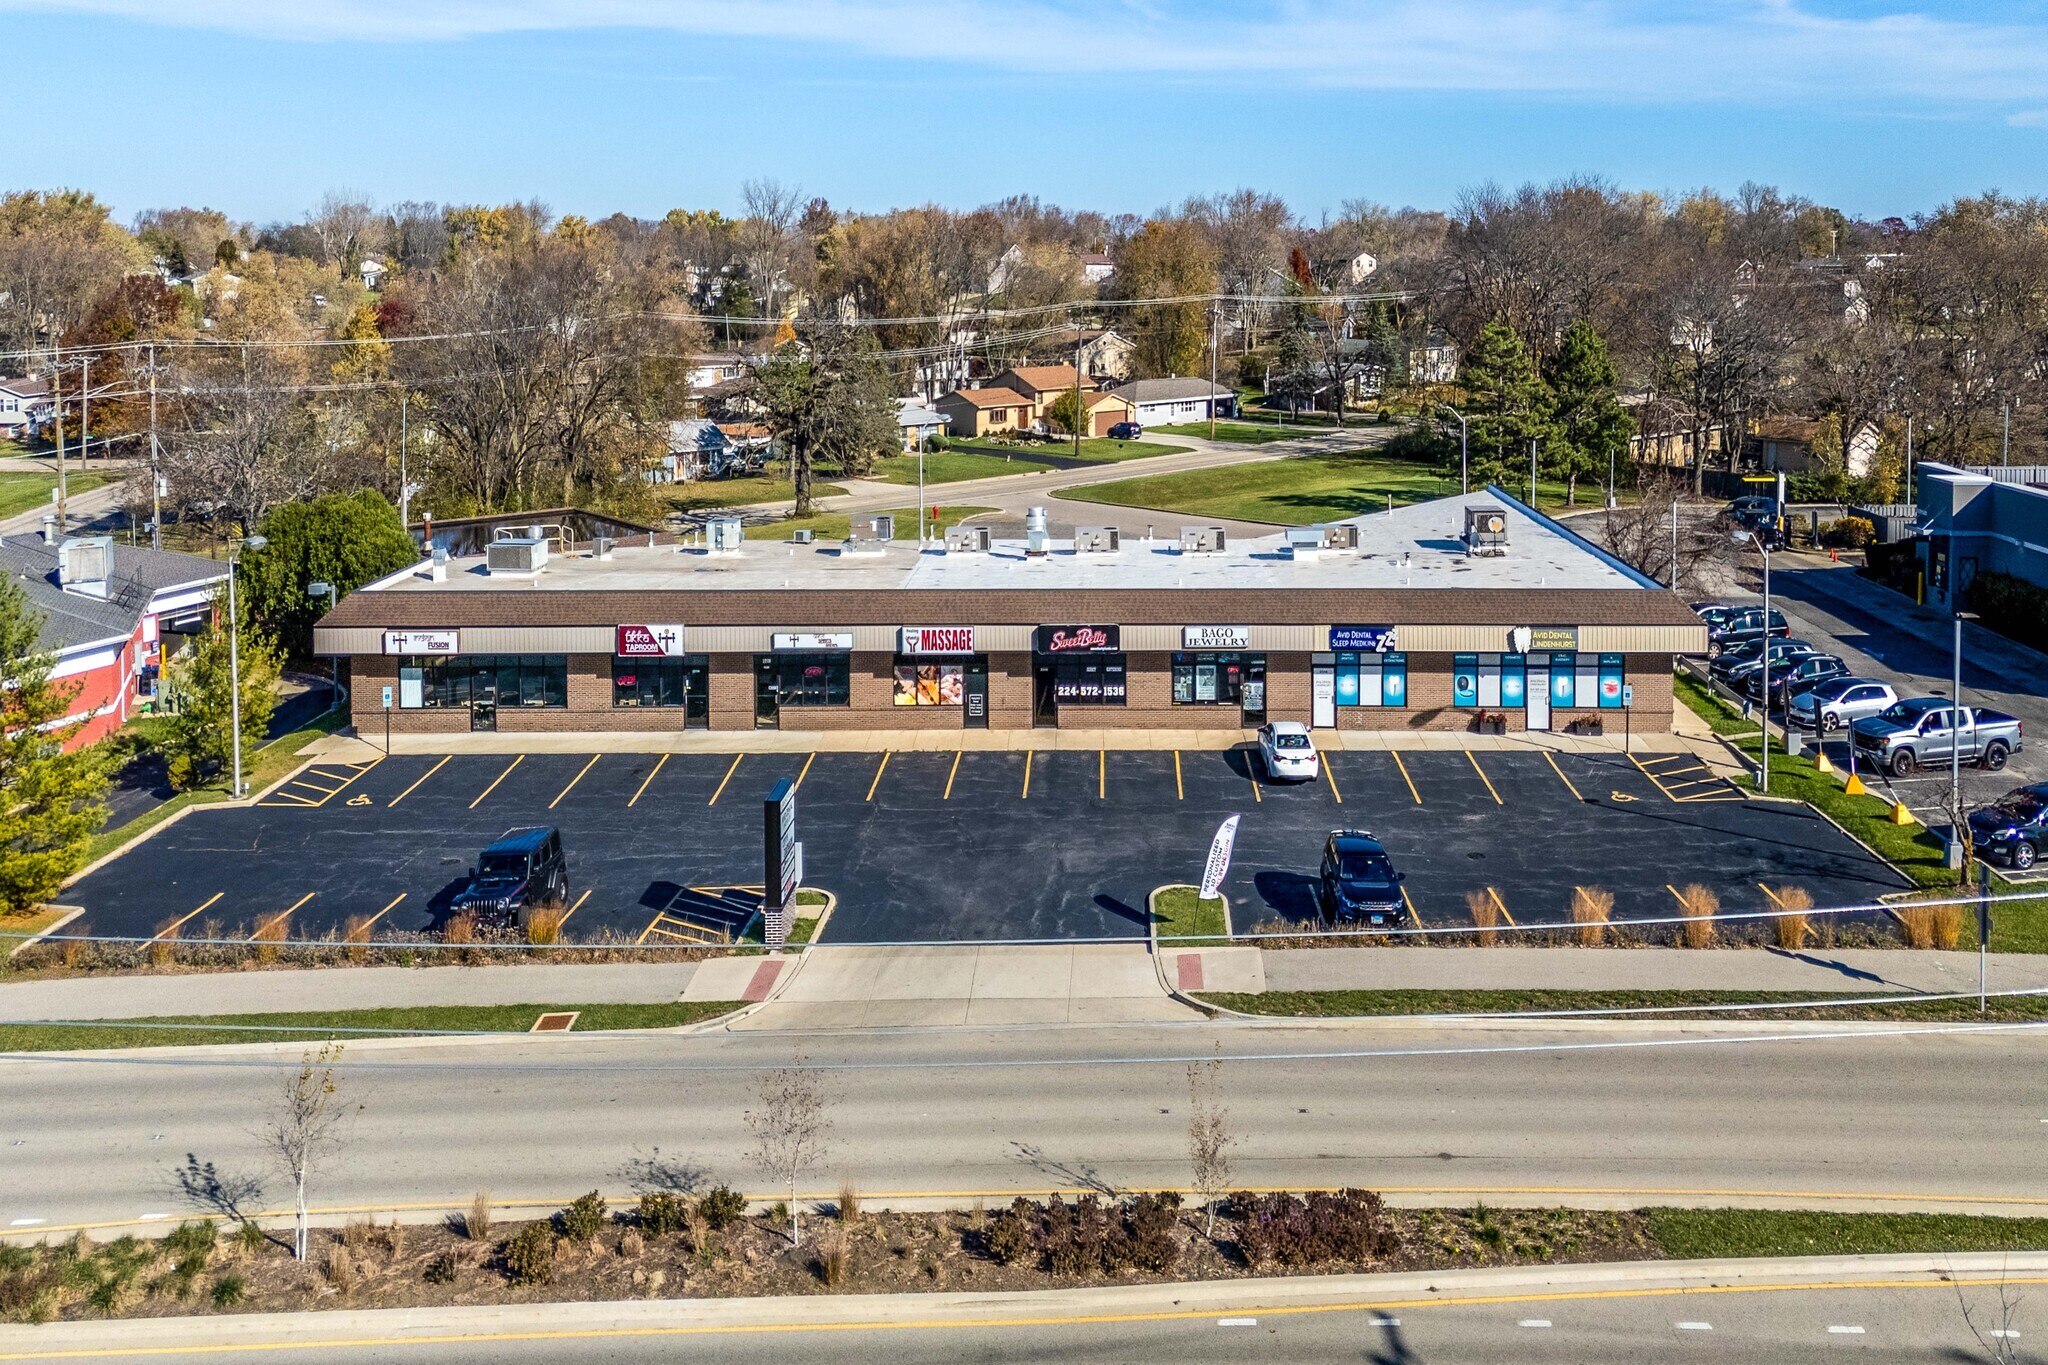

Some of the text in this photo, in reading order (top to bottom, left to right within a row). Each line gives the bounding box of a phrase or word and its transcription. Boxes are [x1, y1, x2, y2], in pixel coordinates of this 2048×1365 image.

[1201, 628, 1233, 638] BAGO
[1337, 631, 1372, 639] AVID DENTAL
[1533, 630, 1573, 639] AVID DENTAL
[921, 629, 972, 651] MASSAGE
[1186, 638, 1248, 646] JEWELRY
[1332, 639, 1349, 647] SLEEP
[1532, 640, 1576, 648] LINDENHURST
[1204, 838, 1220, 893] PERSONALIZED
[1213, 847, 1223, 877] CUSTOM
